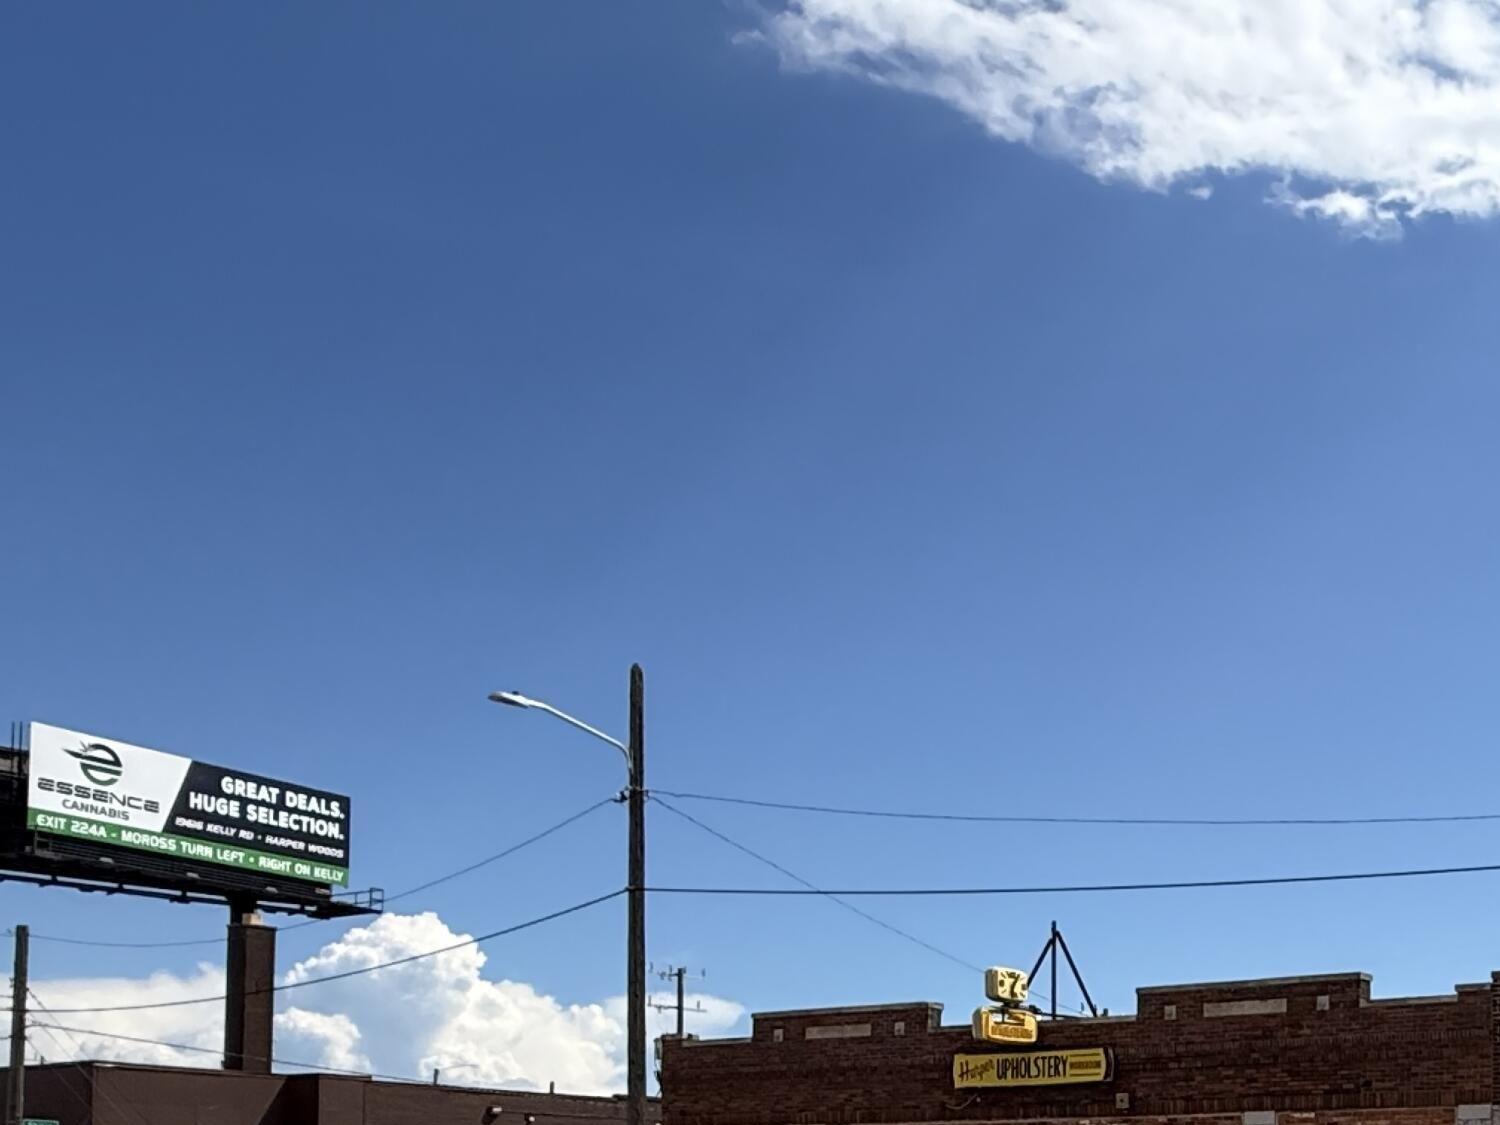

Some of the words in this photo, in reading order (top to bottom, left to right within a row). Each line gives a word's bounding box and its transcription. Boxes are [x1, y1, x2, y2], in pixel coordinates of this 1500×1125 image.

[62, 799, 130, 821] CANNABIS
[189, 792, 240, 818] HUGE
[246, 804, 345, 840] SELECTION.
[221, 776, 280, 804] GREAT
[285, 791, 345, 819] DEALS.
[36, 814, 67, 829] EXIT
[70, 820, 107, 838] 224A
[121, 830, 177, 850] MOROSS
[181, 841, 212, 857] TURN
[216, 848, 246, 864] LEFT
[258, 856, 291, 874] RIGHT
[294, 863, 311, 877] ON
[314, 868, 344, 882] KELLY
[206, 823, 237, 836] KELLY
[238, 829, 254, 840] RD
[265, 835, 305, 851] HARPER
[308, 843, 344, 858] WOODS
[996, 1055, 1069, 1081] UPHOLSTERY
